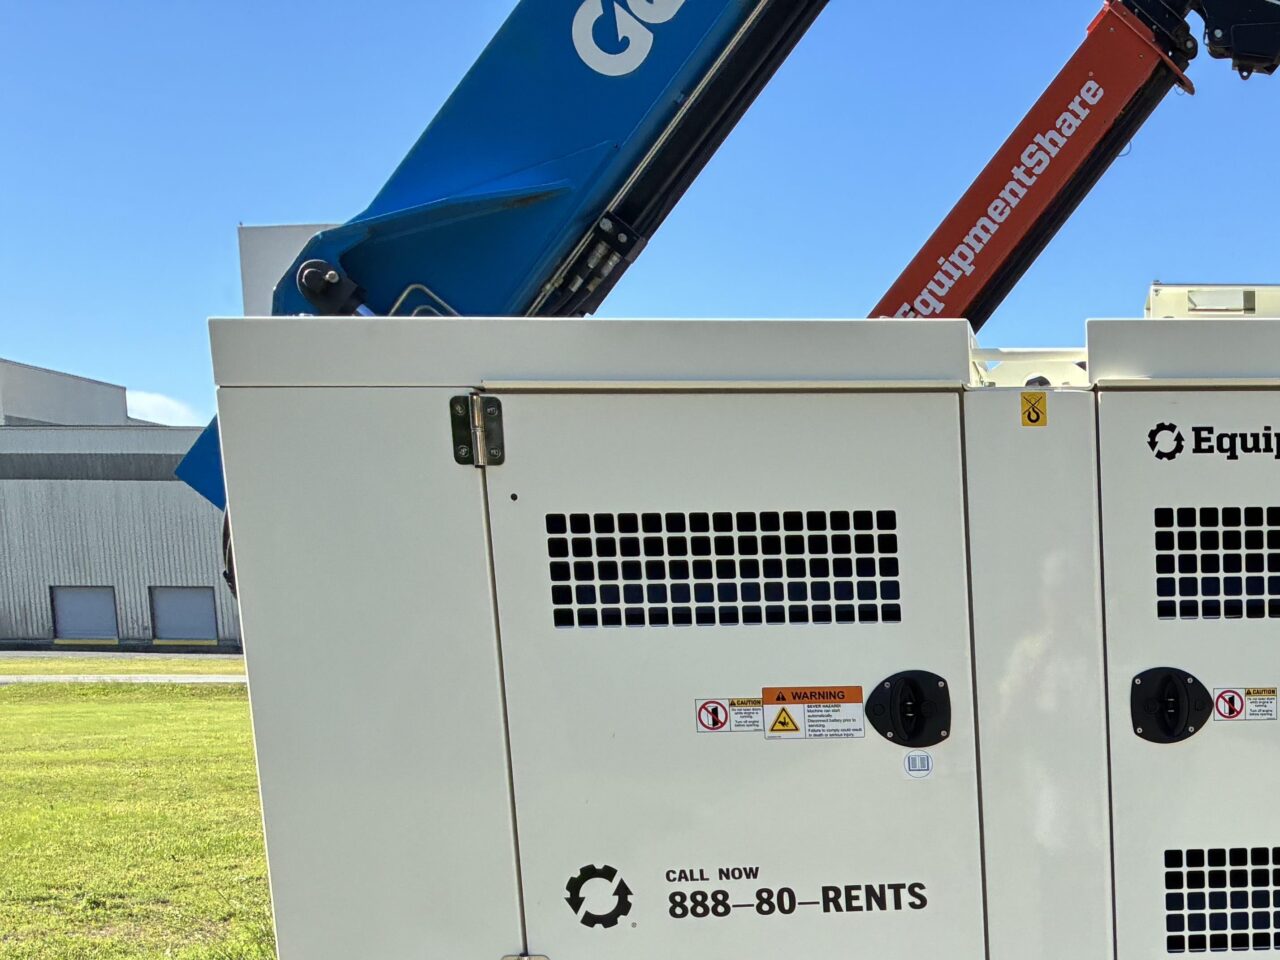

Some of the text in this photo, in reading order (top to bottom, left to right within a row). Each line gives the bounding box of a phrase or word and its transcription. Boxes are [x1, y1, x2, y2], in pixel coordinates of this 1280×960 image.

[790, 690, 846, 700] WARNING
[665, 866, 760, 883] CALL NOW
